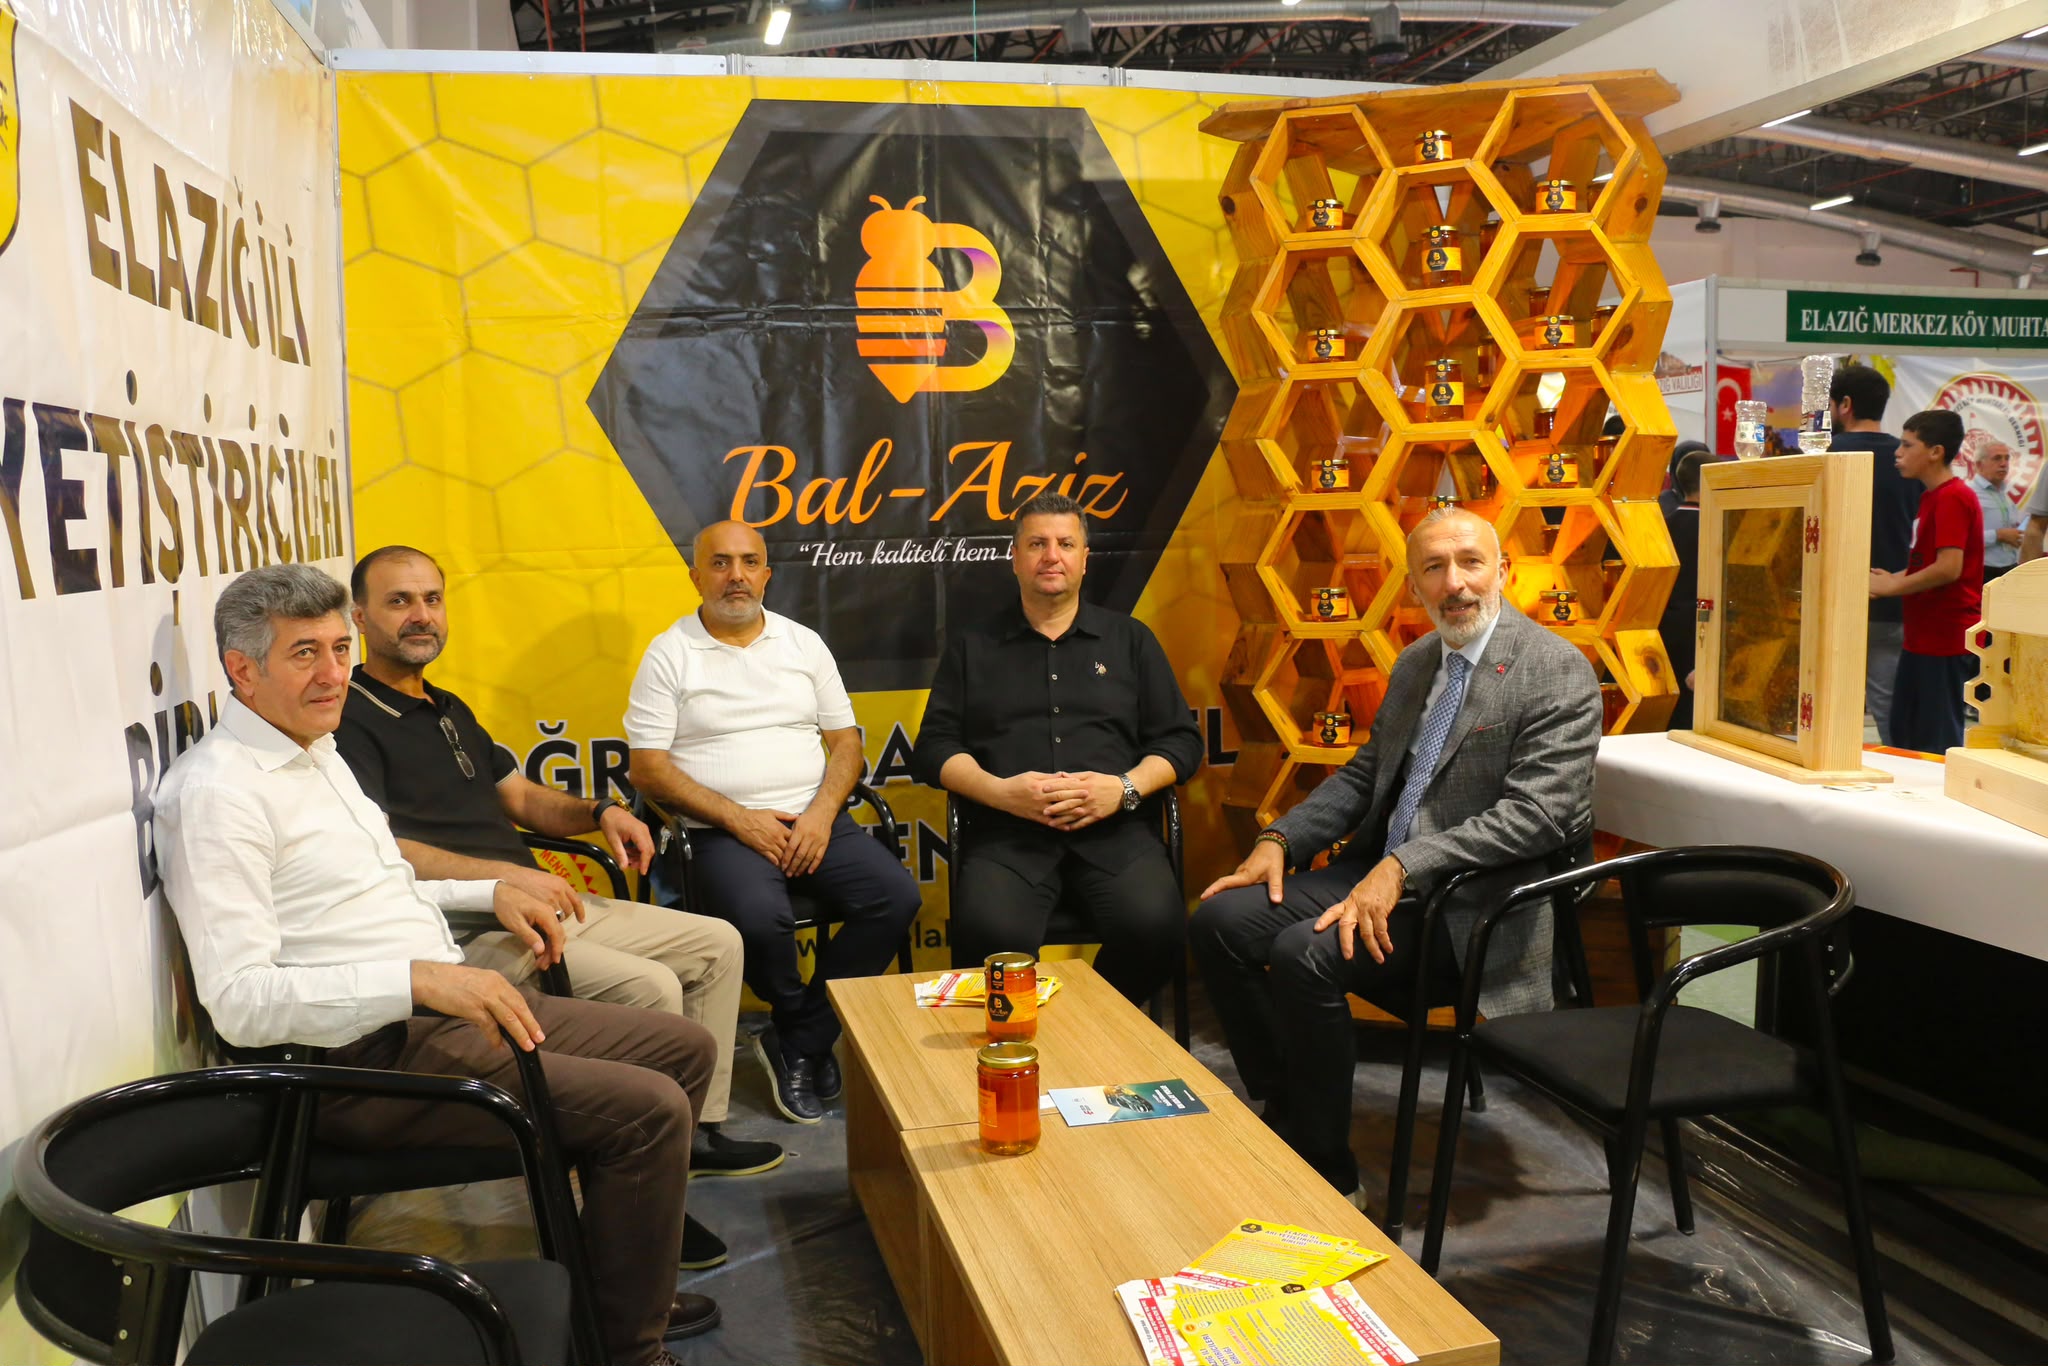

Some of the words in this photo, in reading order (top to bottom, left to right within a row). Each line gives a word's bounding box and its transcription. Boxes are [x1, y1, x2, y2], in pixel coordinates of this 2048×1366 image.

[69, 97, 260, 349] ELAZIĞ
[255, 200, 311, 367] İLİ
[1800, 305, 1868, 333] ELAZIĞ
[1872, 312, 1948, 336] MERKEZ
[1951, 310, 1989, 337] KÖY
[872, 538, 948, 566] kaliteli
[953, 539, 998, 563] hem
